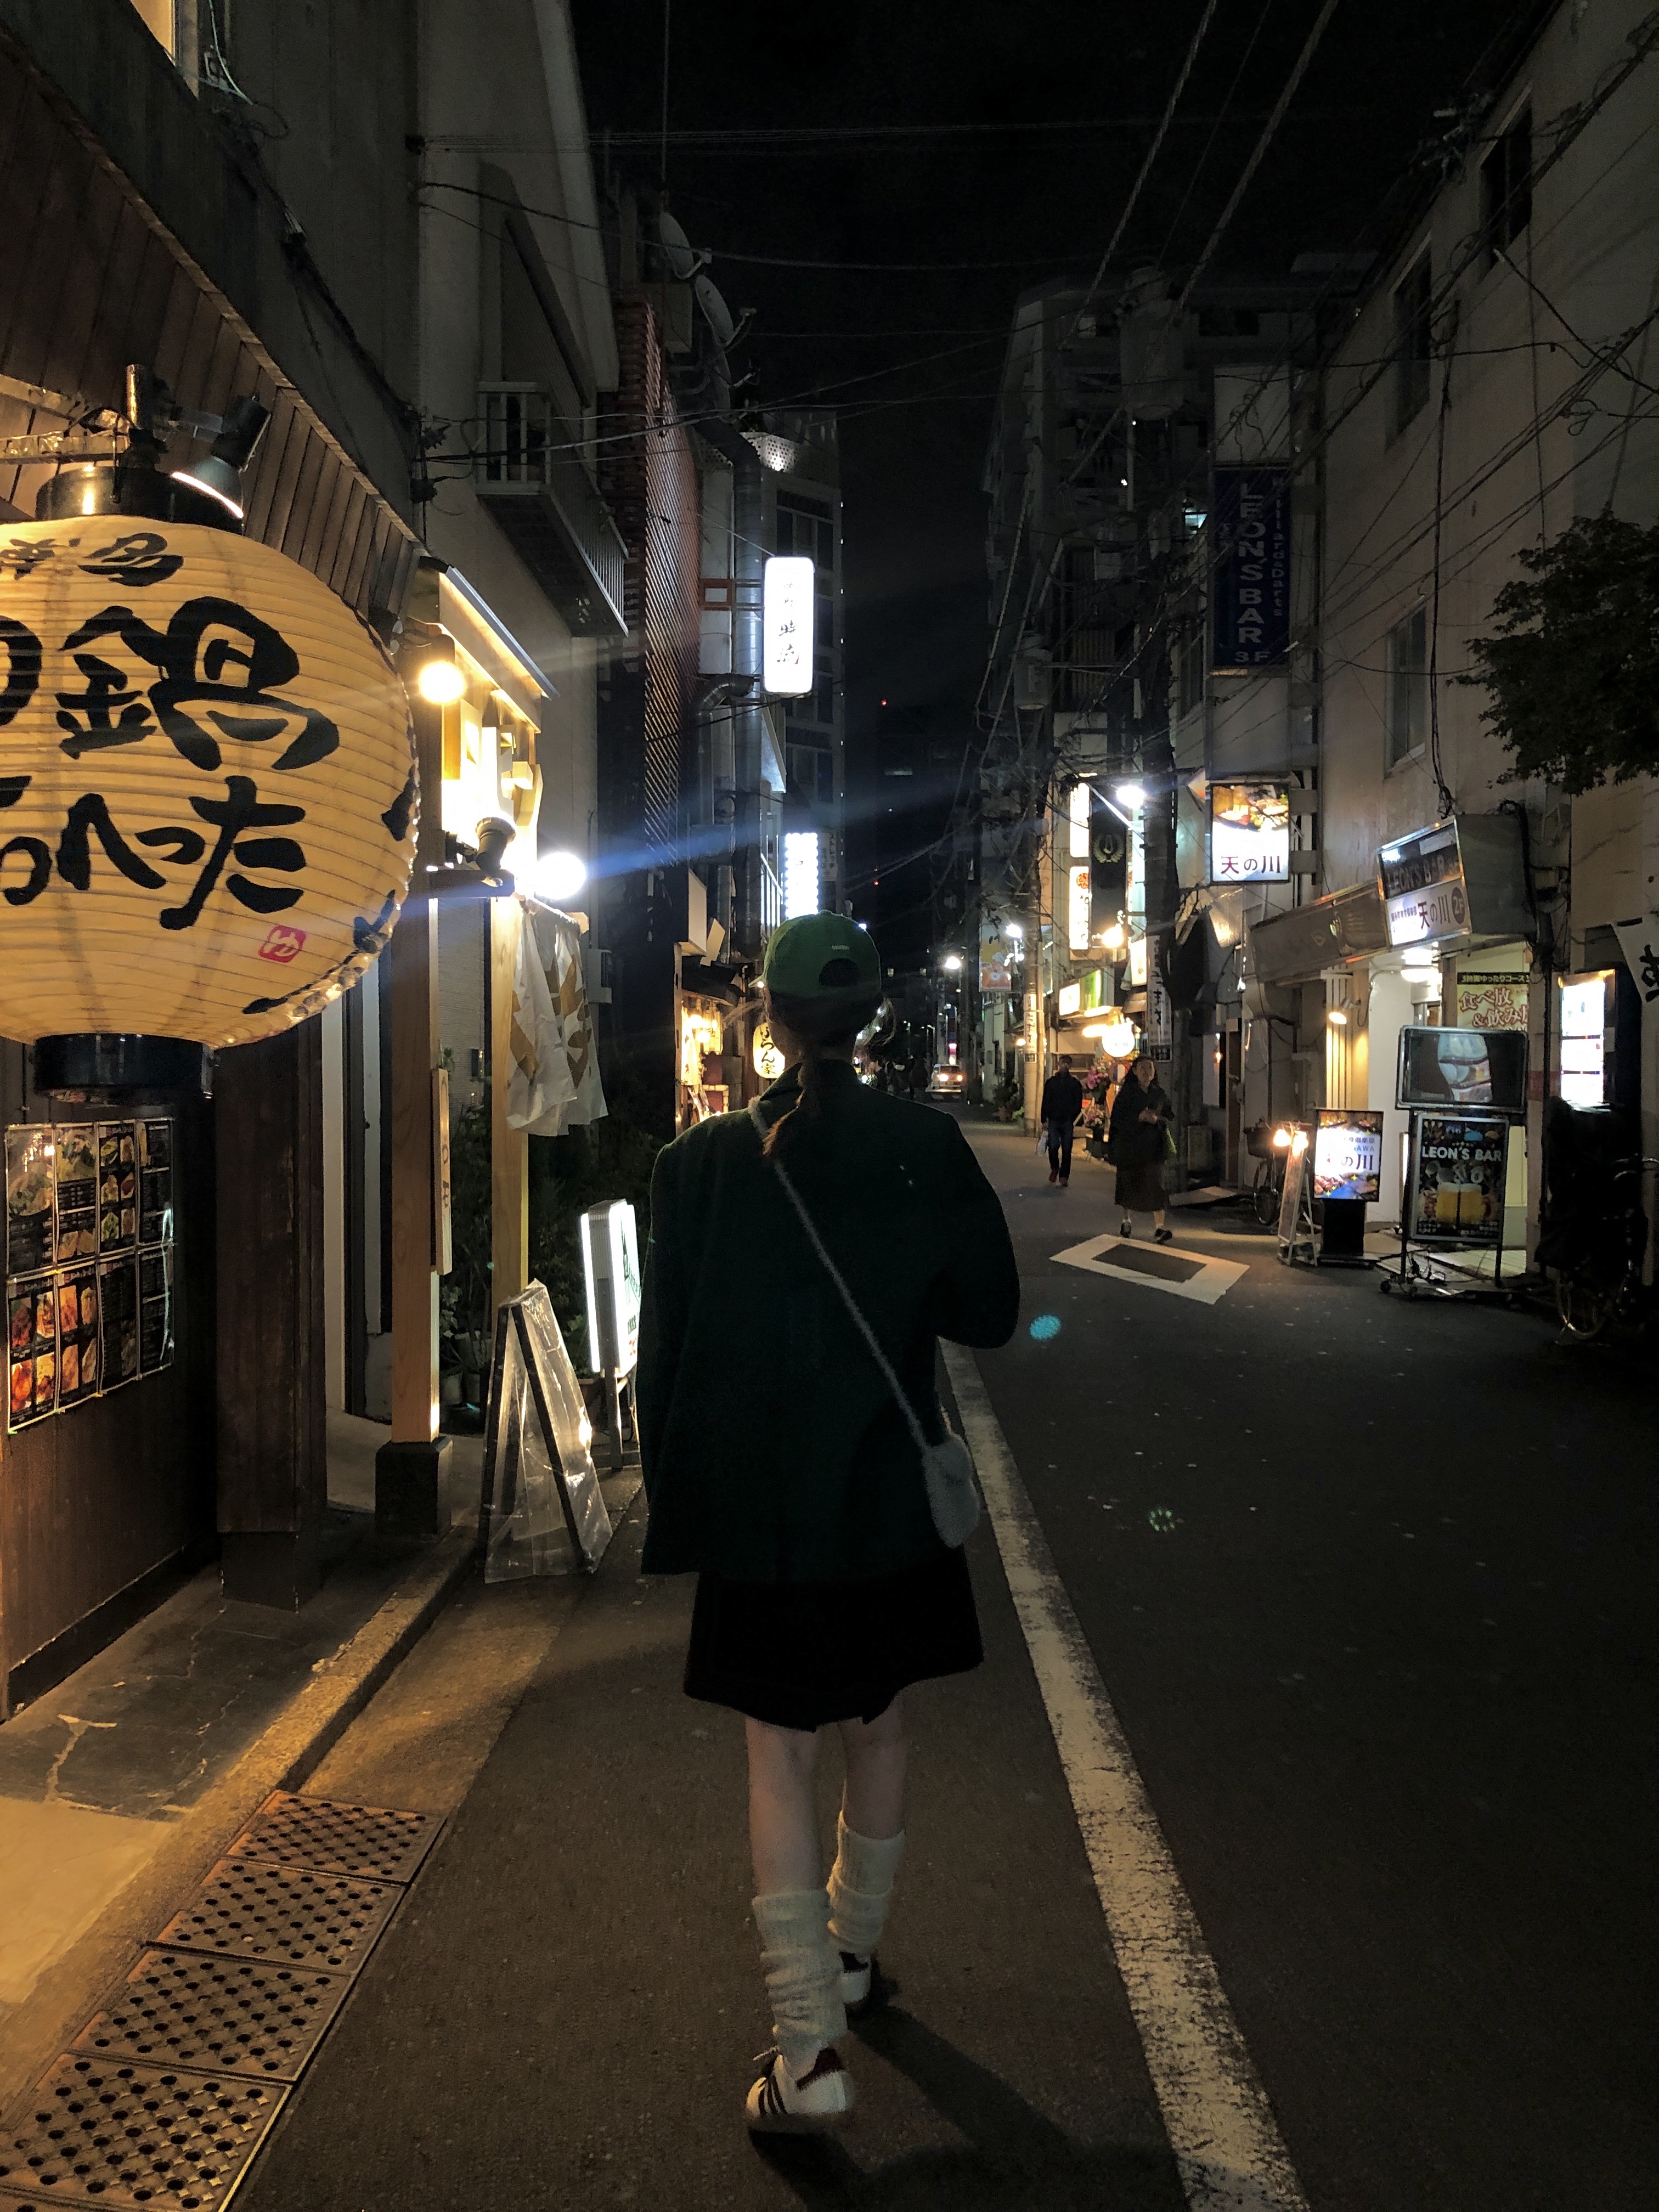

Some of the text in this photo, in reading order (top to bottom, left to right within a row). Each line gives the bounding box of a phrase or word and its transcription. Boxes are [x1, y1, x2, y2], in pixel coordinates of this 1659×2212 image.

[1237, 483, 1268, 643] LEON'S BAR
[1234, 650, 1271, 663] 3F
[1220, 855, 1282, 874] 天の川
[1418, 894, 1451, 930] 天の川
[1453, 895, 1464, 915] 2F
[1422, 1146, 1502, 1162] LEON'S BAR
